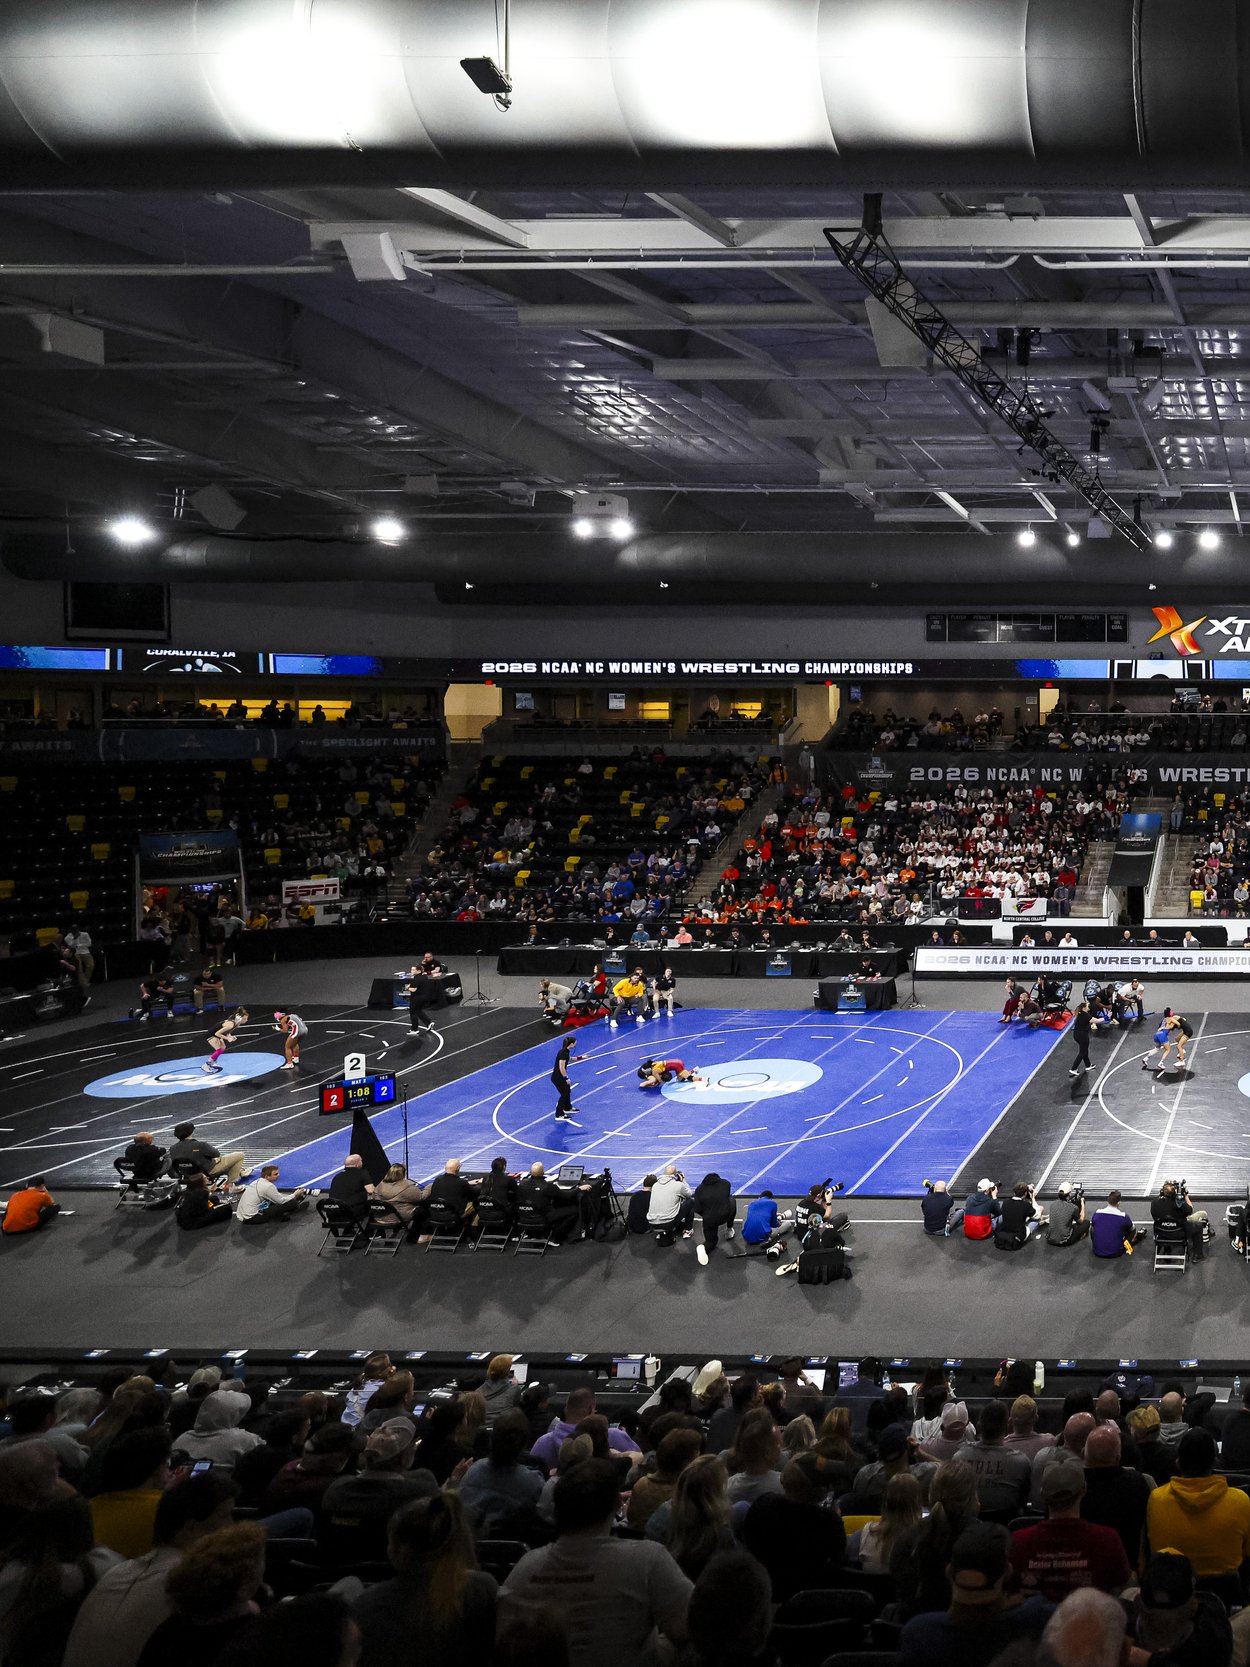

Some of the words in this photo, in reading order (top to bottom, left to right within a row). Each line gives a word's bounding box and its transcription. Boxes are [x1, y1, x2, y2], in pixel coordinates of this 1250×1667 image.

[481, 662, 537, 673] 2026
[541, 662, 580, 674] NCAA
[585, 662, 604, 673] NC
[608, 662, 676, 674] WOMEN'S
[680, 662, 799, 674] WRESTLING
[804, 662, 913, 674] CHAMPIONSHIPS
[910, 767, 980, 781] 2026
[1041, 768, 1062, 782] NC
[157, 849, 221, 858] CHAMPIONSHIPS
[285, 883, 338, 898] ESPN
[925, 955, 971, 964] 2026
[975, 955, 1006, 964] NCAA
[1012, 955, 1027, 964] NC
[1032, 955, 1089, 964] WOMEN'S
[1094, 956, 1193, 965] WRESTLING
[350, 1058, 361, 1071] 2
[348, 1087, 370, 1098] 1:08
[381, 1086, 388, 1096] 2
[330, 1095, 338, 1106] 2
